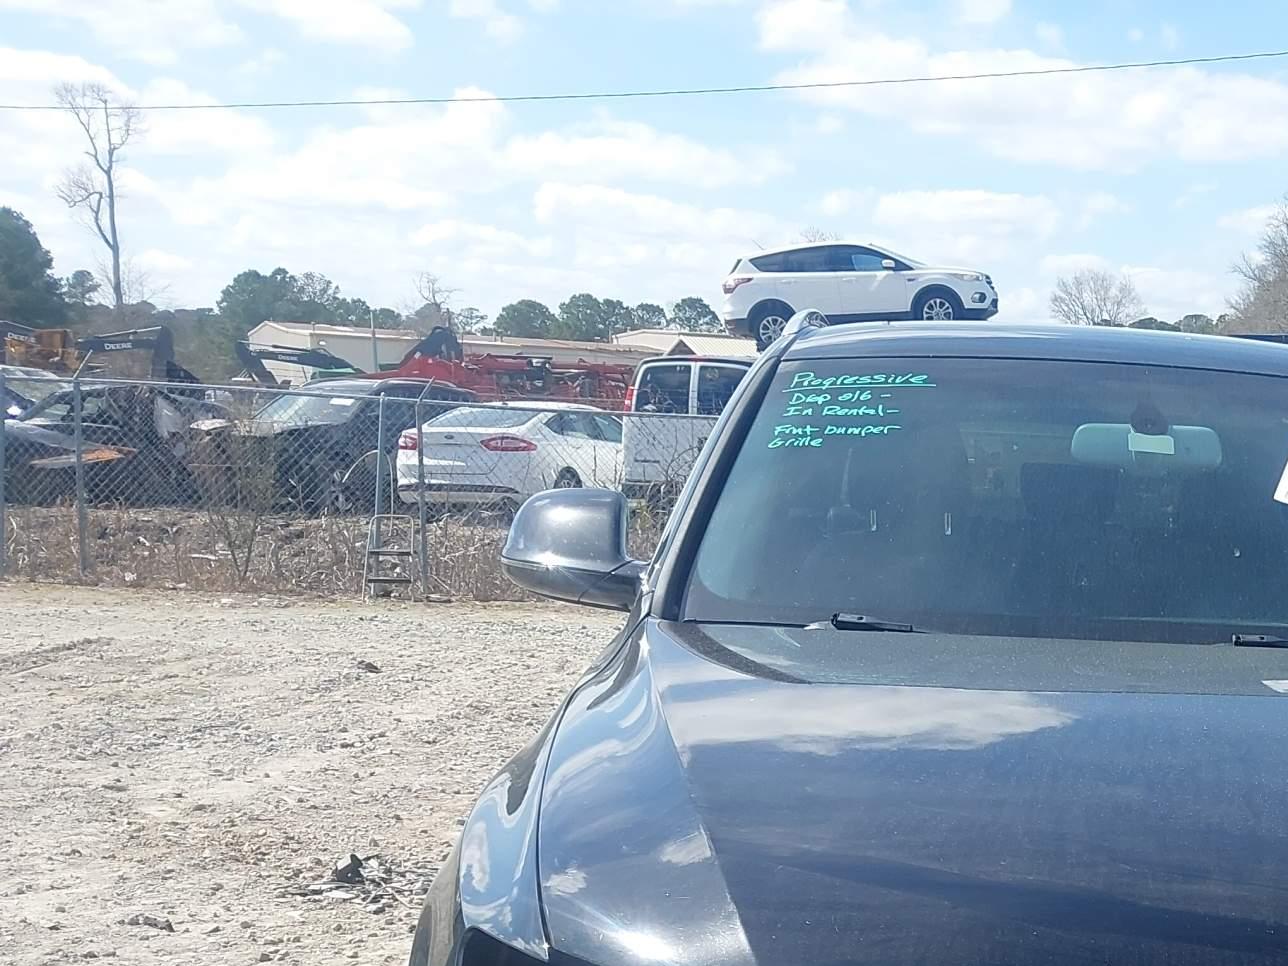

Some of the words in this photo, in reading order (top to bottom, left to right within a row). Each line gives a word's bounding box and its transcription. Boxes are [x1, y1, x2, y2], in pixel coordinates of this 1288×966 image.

[790, 371, 928, 389] Progressive
[783, 406, 812, 416] In
[822, 405, 884, 416] Rental
